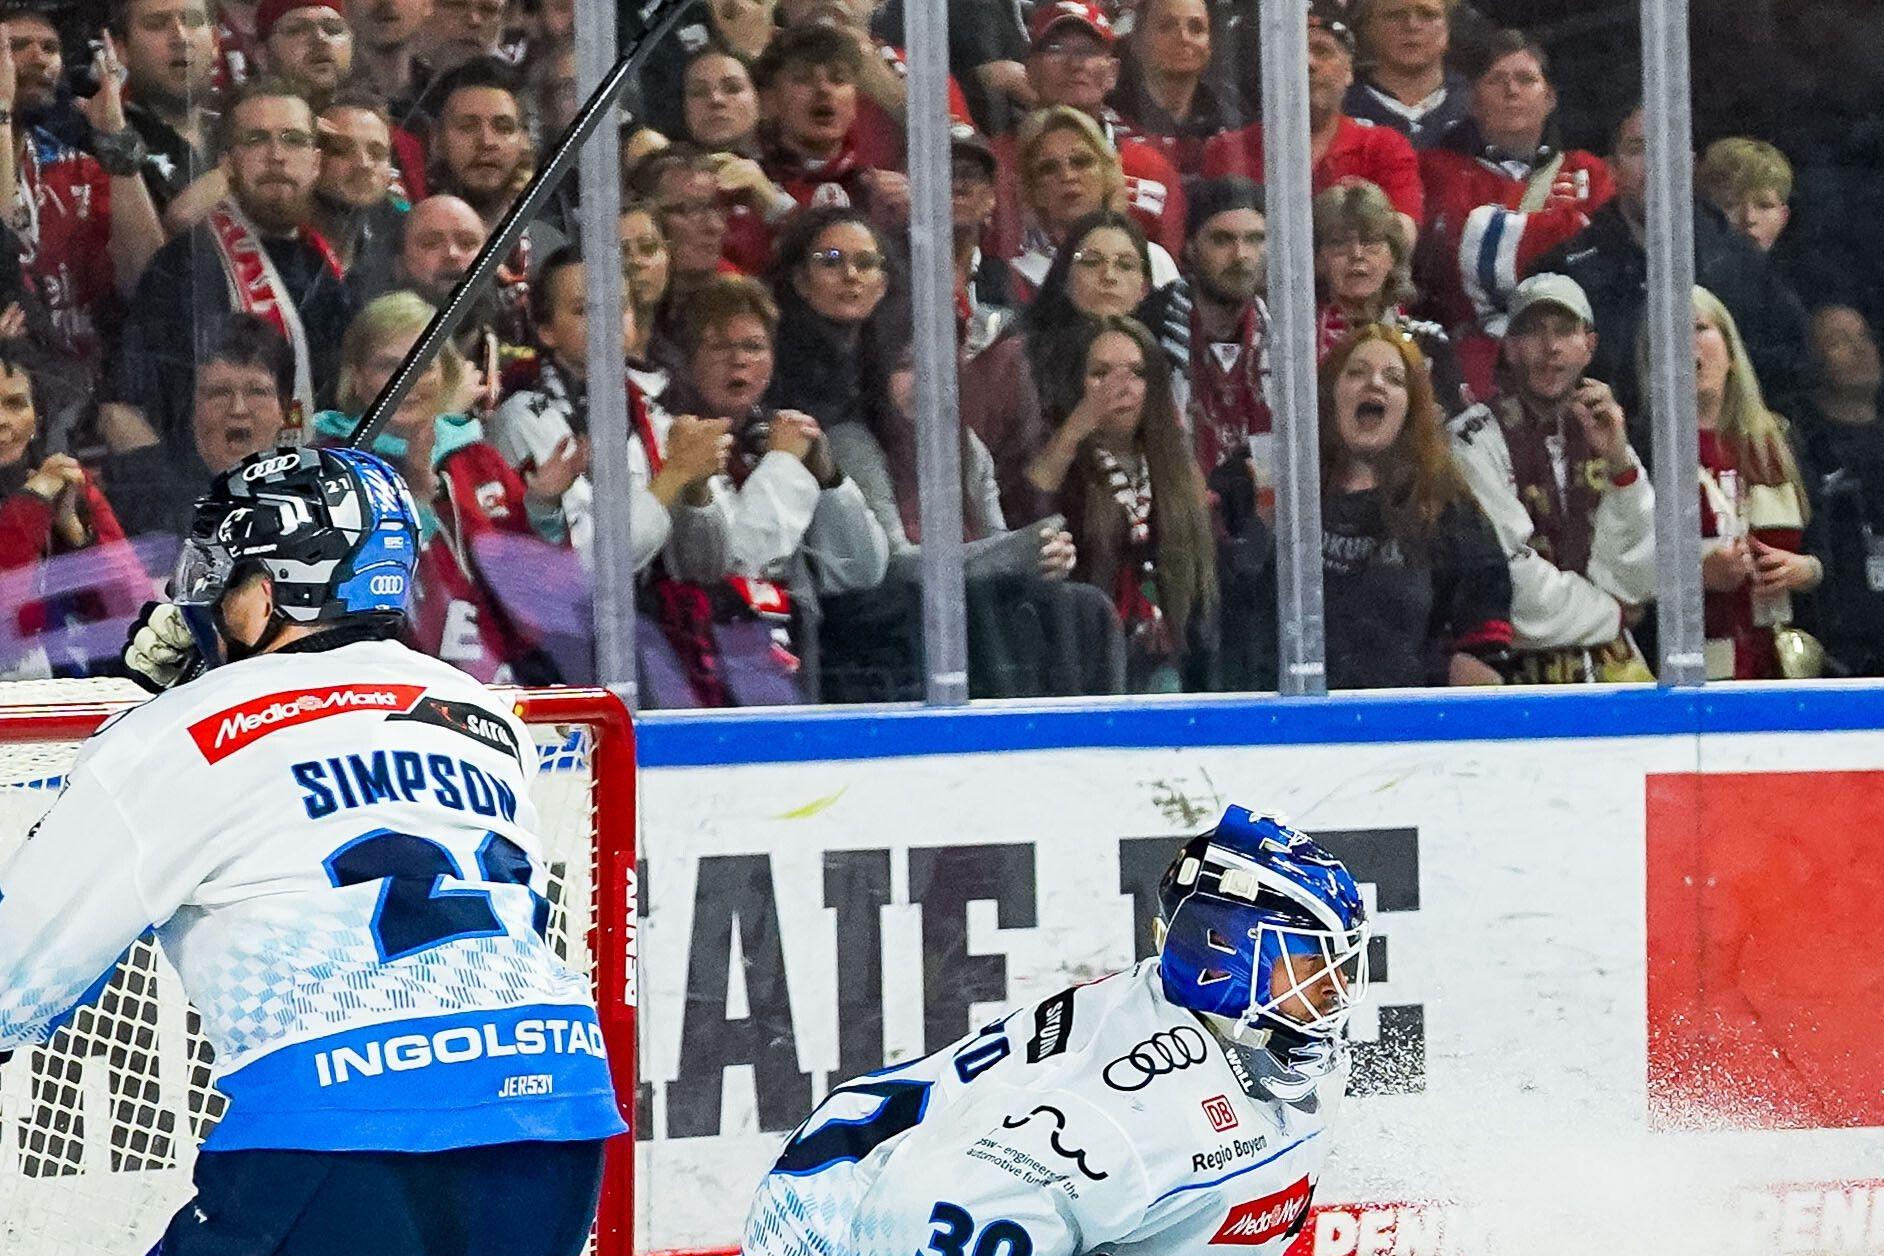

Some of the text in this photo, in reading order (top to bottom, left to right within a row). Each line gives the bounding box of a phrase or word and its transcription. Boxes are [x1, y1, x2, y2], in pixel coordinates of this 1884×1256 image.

[325, 478, 350, 493] 21
[291, 750, 517, 824] SIMPSON
[1206, 1101, 1233, 1127] DB
[1192, 1143, 1233, 1173] Regio
[1064, 1177, 1080, 1201] the
